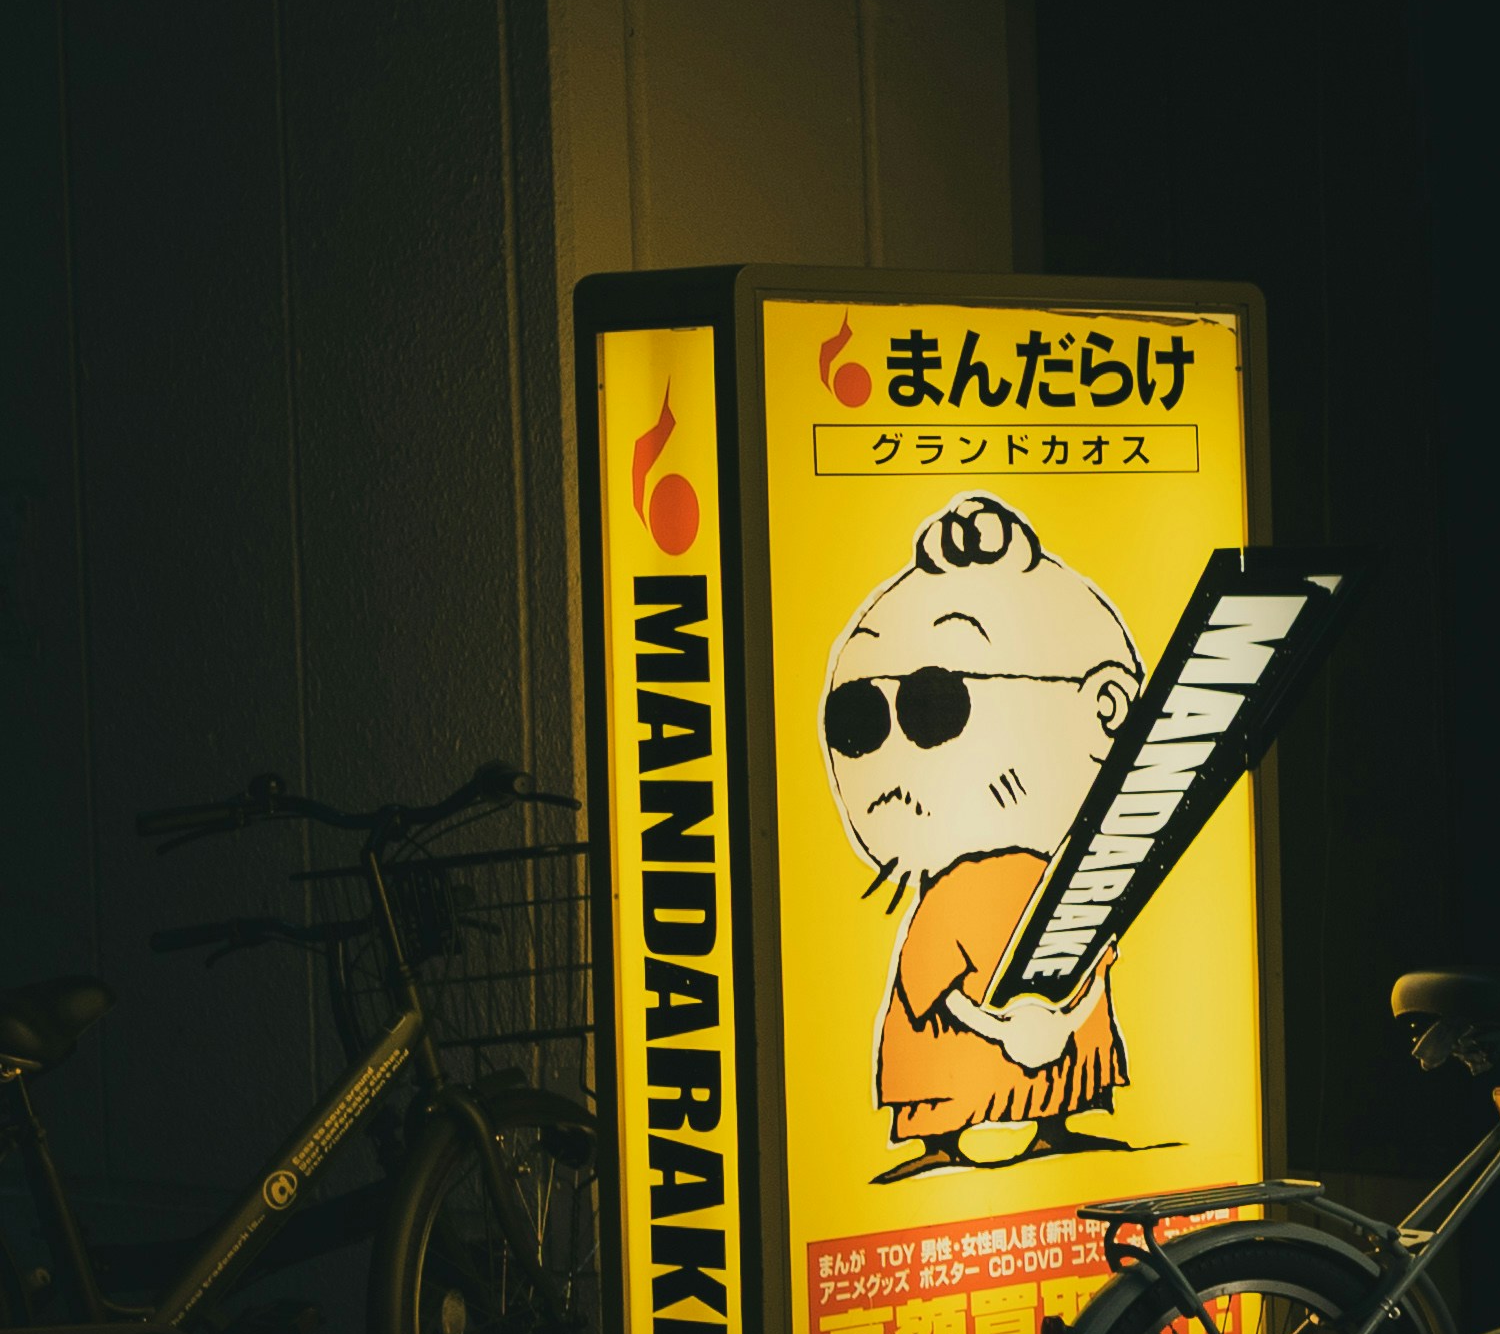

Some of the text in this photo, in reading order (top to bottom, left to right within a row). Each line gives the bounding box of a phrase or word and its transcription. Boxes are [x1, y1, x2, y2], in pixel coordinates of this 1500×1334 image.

[885, 329, 1196, 411] まんだらけ
[872, 431, 1151, 466] グランドカオス
[1021, 594, 1303, 985] MANDARAKE
[345, 1066, 375, 1102] around
[818, 1248, 866, 1279] まんが
[876, 1242, 917, 1269] TOY
[818, 1275, 911, 1305] アニメグッズ
[918, 1264, 981, 1291] ポスター
[987, 1246, 1064, 1279] CD・DVD
